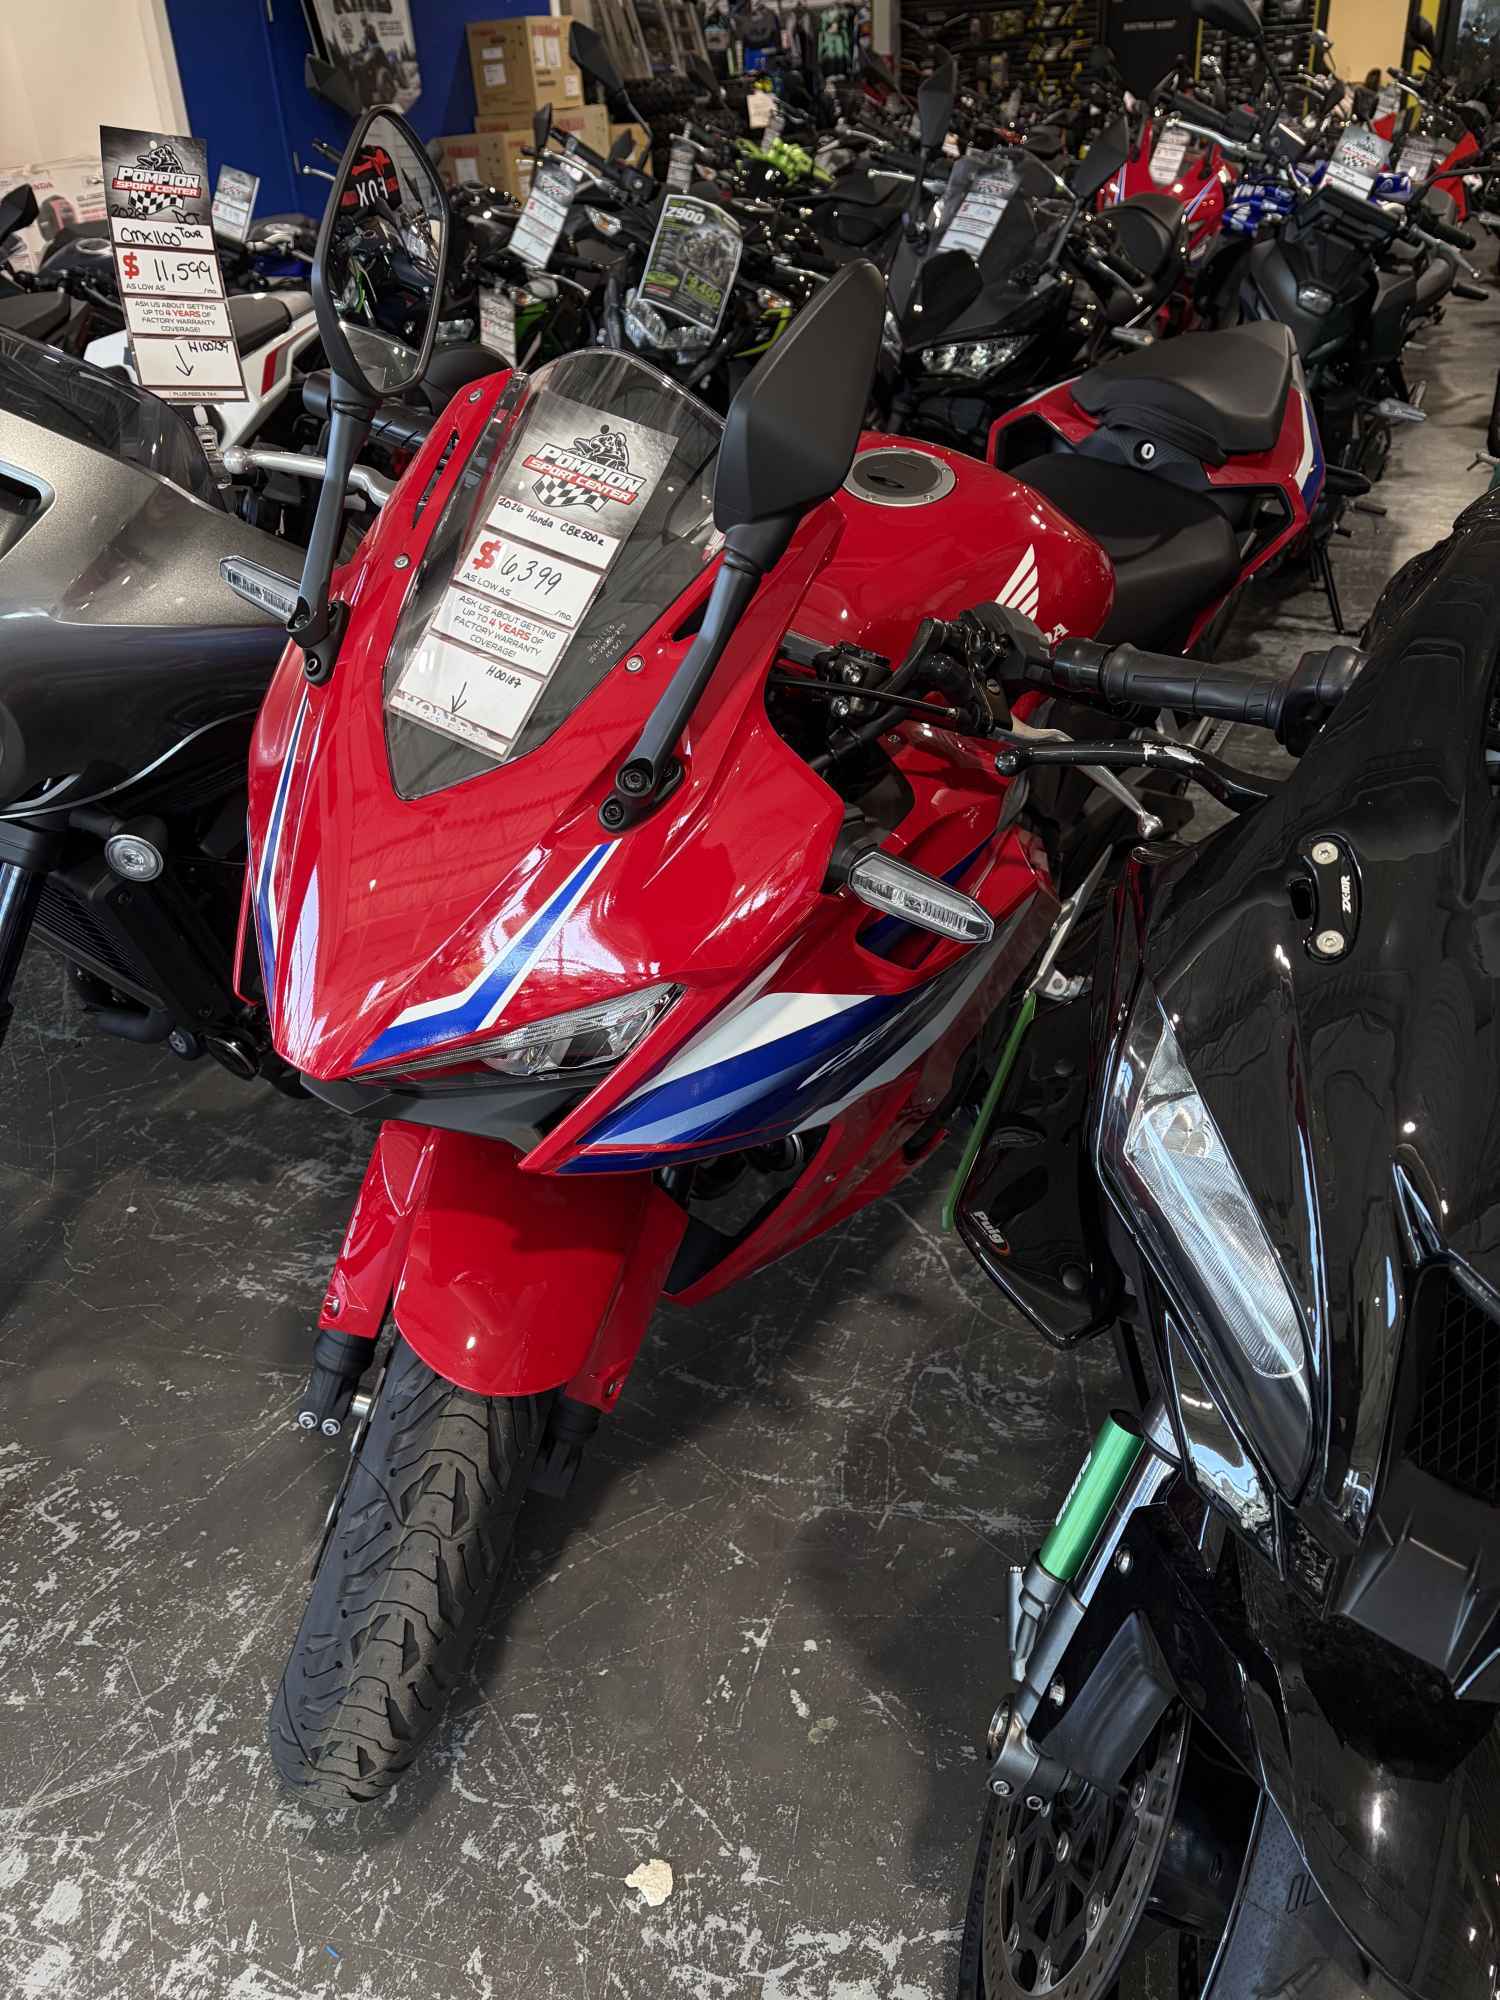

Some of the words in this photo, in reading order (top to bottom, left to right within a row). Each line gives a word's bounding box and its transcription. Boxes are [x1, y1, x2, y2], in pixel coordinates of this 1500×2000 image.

[116, 180, 153, 191] SPORT
[154, 184, 198, 196] CENTER
[117, 165, 200, 188] POMPTON
[664, 206, 706, 225] Z900
[122, 252, 140, 279] $
[153, 257, 215, 285] 11,599
[126, 282, 137, 290] AS
[138, 283, 154, 291] LOW
[172, 310, 201, 318] YEARS
[186, 303, 217, 311] GETTING
[176, 318, 216, 326] WARRANTY
[529, 458, 577, 481] SPORT
[576, 475, 632, 501] CENTER
[535, 443, 646, 493] POMPTON
[497, 497, 524, 513] 2026
[526, 509, 554, 529] Honda
[472, 540, 502, 571] $
[500, 553, 562, 596] 6,399
[463, 571, 479, 583] AS
[478, 577, 498, 592] LOW
[498, 586, 512, 598] AS
[458, 595, 477, 608] ASK
[478, 602, 490, 614] US
[490, 606, 521, 625] ABOUT
[520, 620, 557, 640] GETTING
[462, 607, 476, 619] UP
[477, 612, 489, 624] TO
[498, 621, 530, 641] YEARS
[530, 635, 544, 645] OF
[453, 615, 495, 637] FACTORY
[494, 631, 542, 655] WARRANTY
[469, 634, 518, 657] COVERAGE!
[973, 1209, 1005, 1244] Puig
